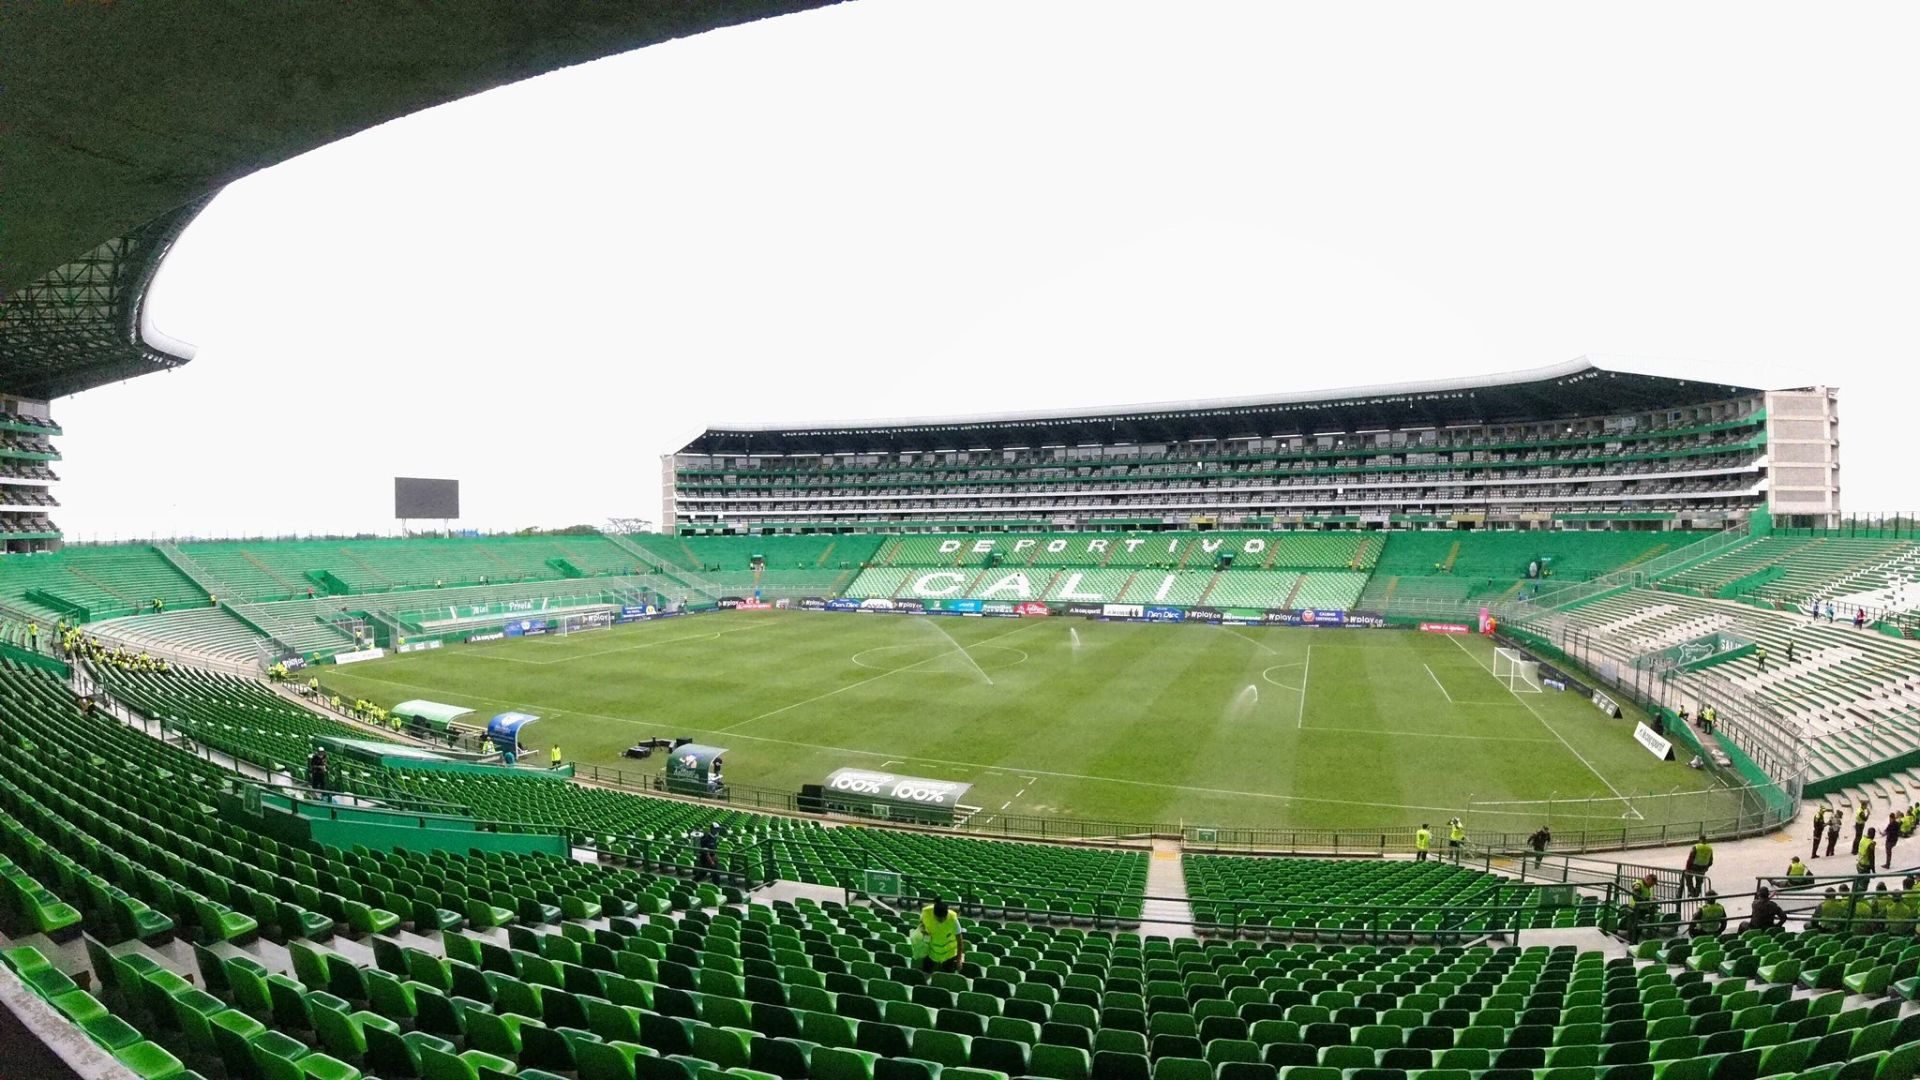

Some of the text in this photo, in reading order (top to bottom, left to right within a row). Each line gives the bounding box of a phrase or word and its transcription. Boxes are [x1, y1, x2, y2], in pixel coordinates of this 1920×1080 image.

[939, 539, 1265, 553] DEPORTIVO
[912, 571, 1176, 600] CALI
[831, 775, 880, 793] 100%
[890, 783, 944, 802] 100%
[878, 882, 887, 892] 2
